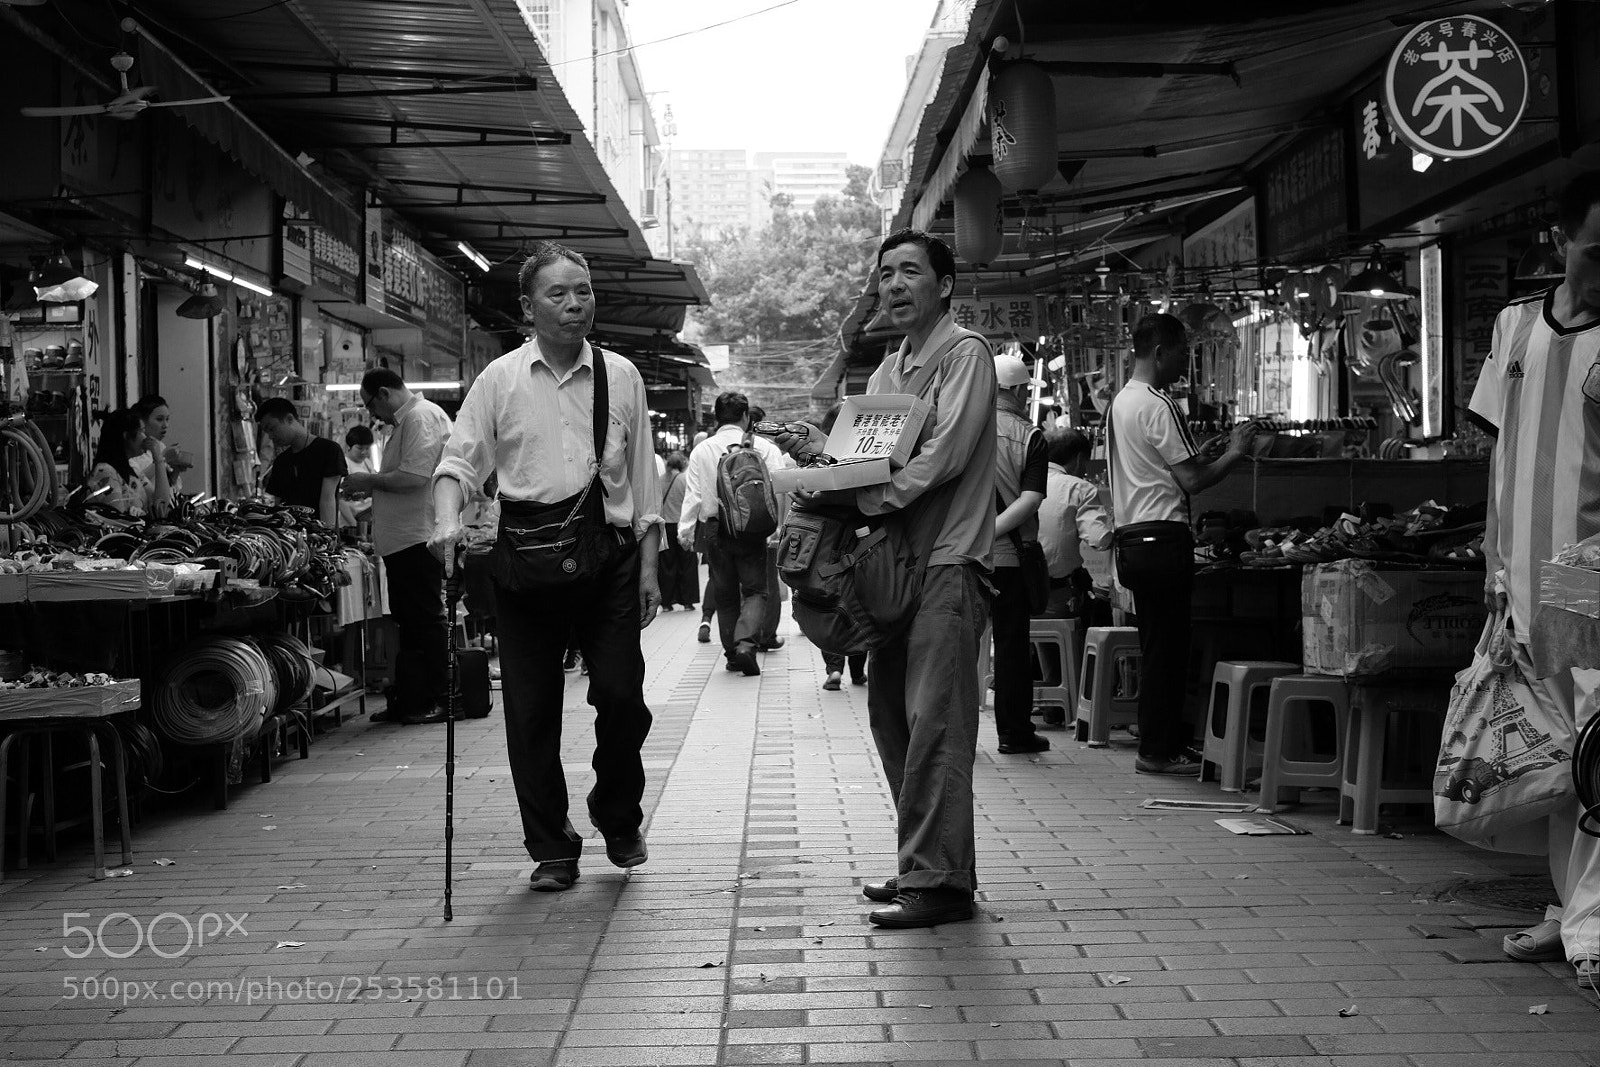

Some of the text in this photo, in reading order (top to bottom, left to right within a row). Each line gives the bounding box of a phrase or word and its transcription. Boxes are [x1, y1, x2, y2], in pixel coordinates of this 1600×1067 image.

[1403, 21, 1515, 66] 老字号春兴店
[1411, 39, 1505, 148] 茶
[952, 301, 1032, 329] 净水器
